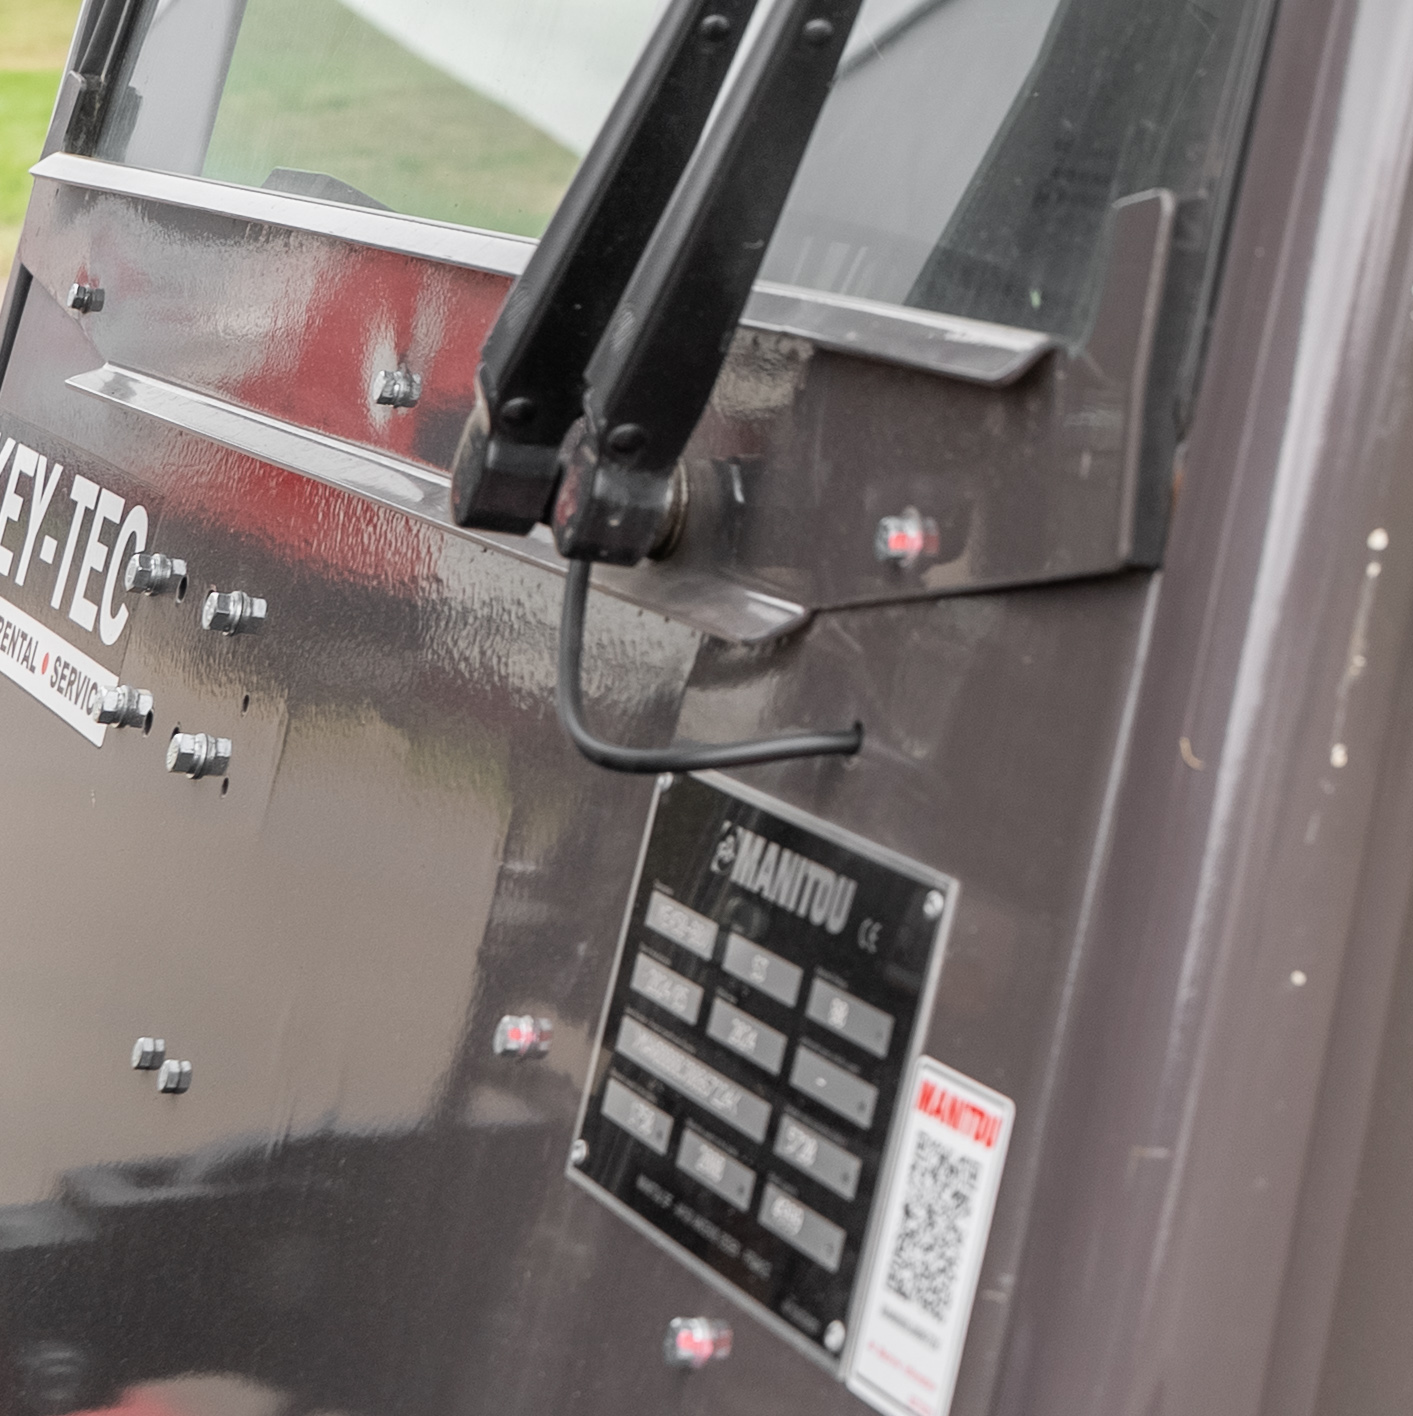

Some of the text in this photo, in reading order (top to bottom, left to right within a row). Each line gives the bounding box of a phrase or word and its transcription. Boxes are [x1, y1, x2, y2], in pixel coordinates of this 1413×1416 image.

[0, 436, 149, 647] EY-TEC
[50, 655, 99, 716] SERVIC
[729, 827, 859, 936] MANITOU
[916, 1079, 1003, 1150] MANITOU
